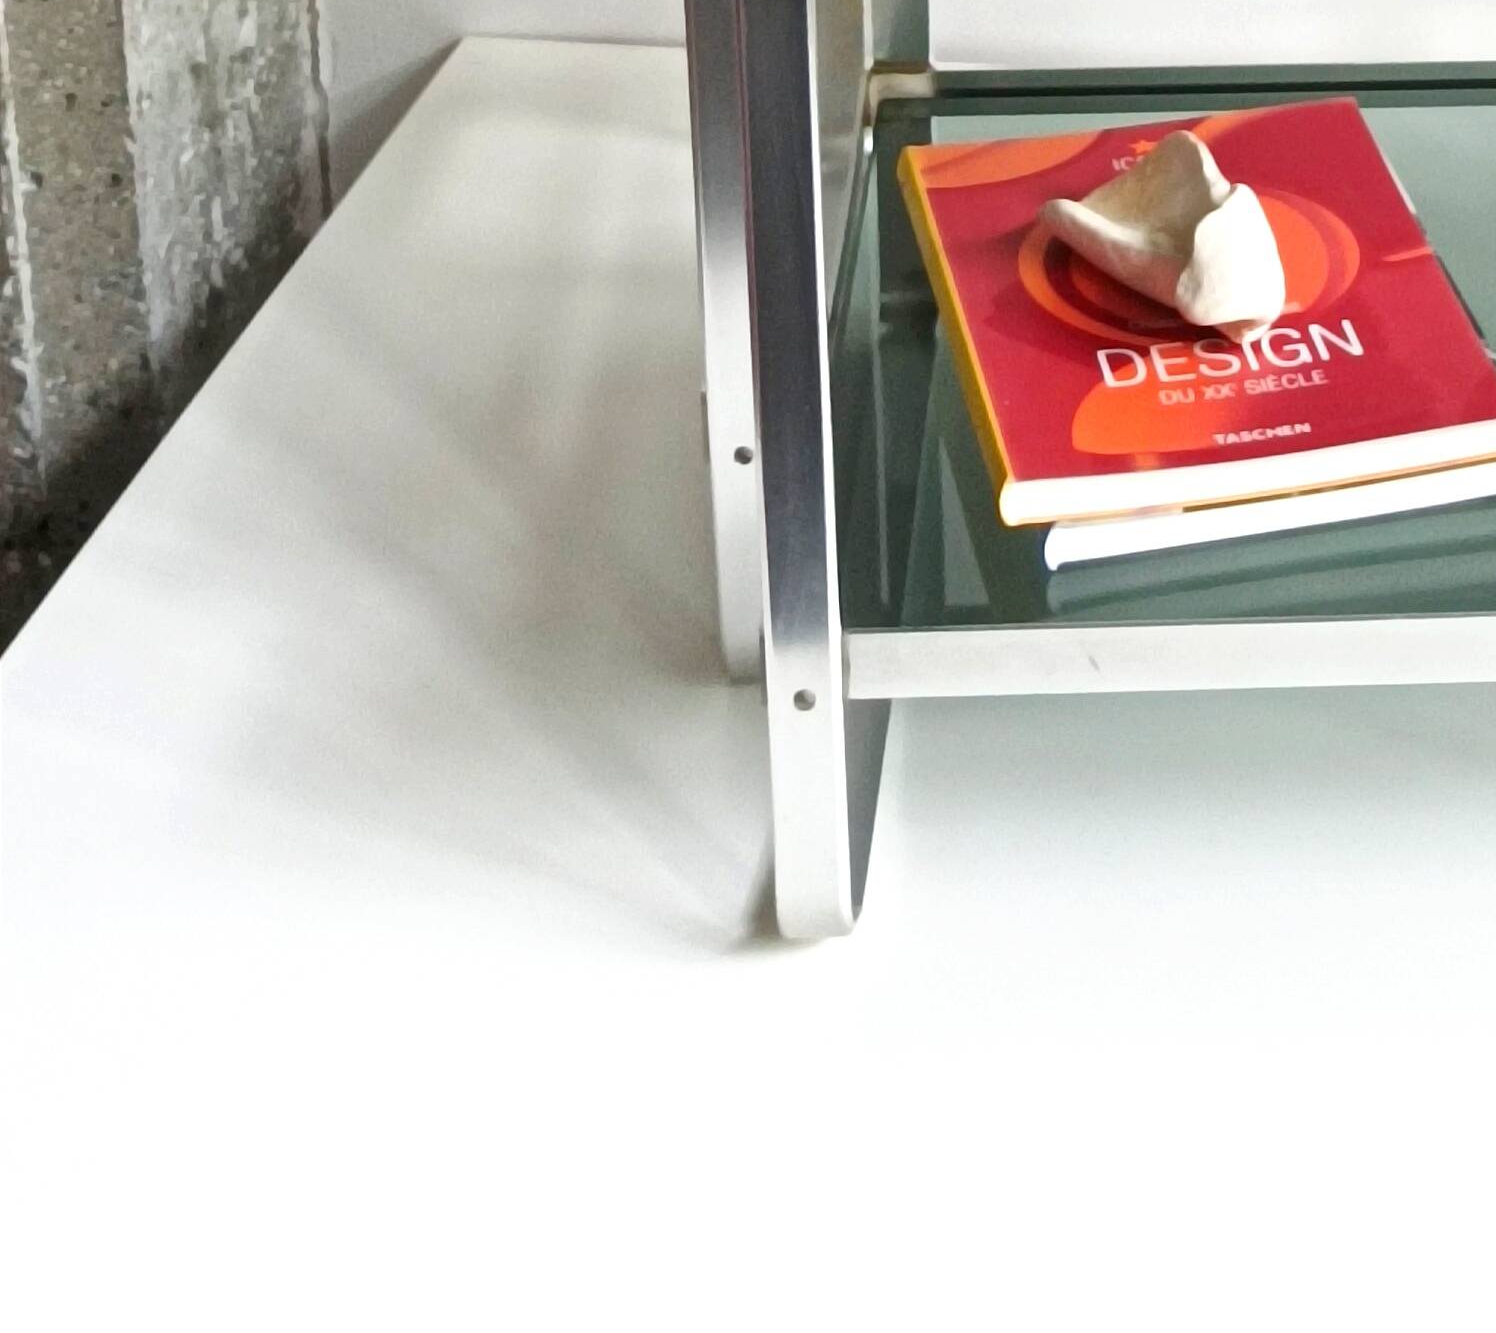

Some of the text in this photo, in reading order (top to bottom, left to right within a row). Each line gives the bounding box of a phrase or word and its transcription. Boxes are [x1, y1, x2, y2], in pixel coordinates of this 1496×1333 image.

[1096, 318, 1365, 389] DESIGN
[1157, 388, 1196, 406] DU
[1243, 368, 1329, 396] SIÈCLE
[1211, 422, 1312, 445] TASCHEN
